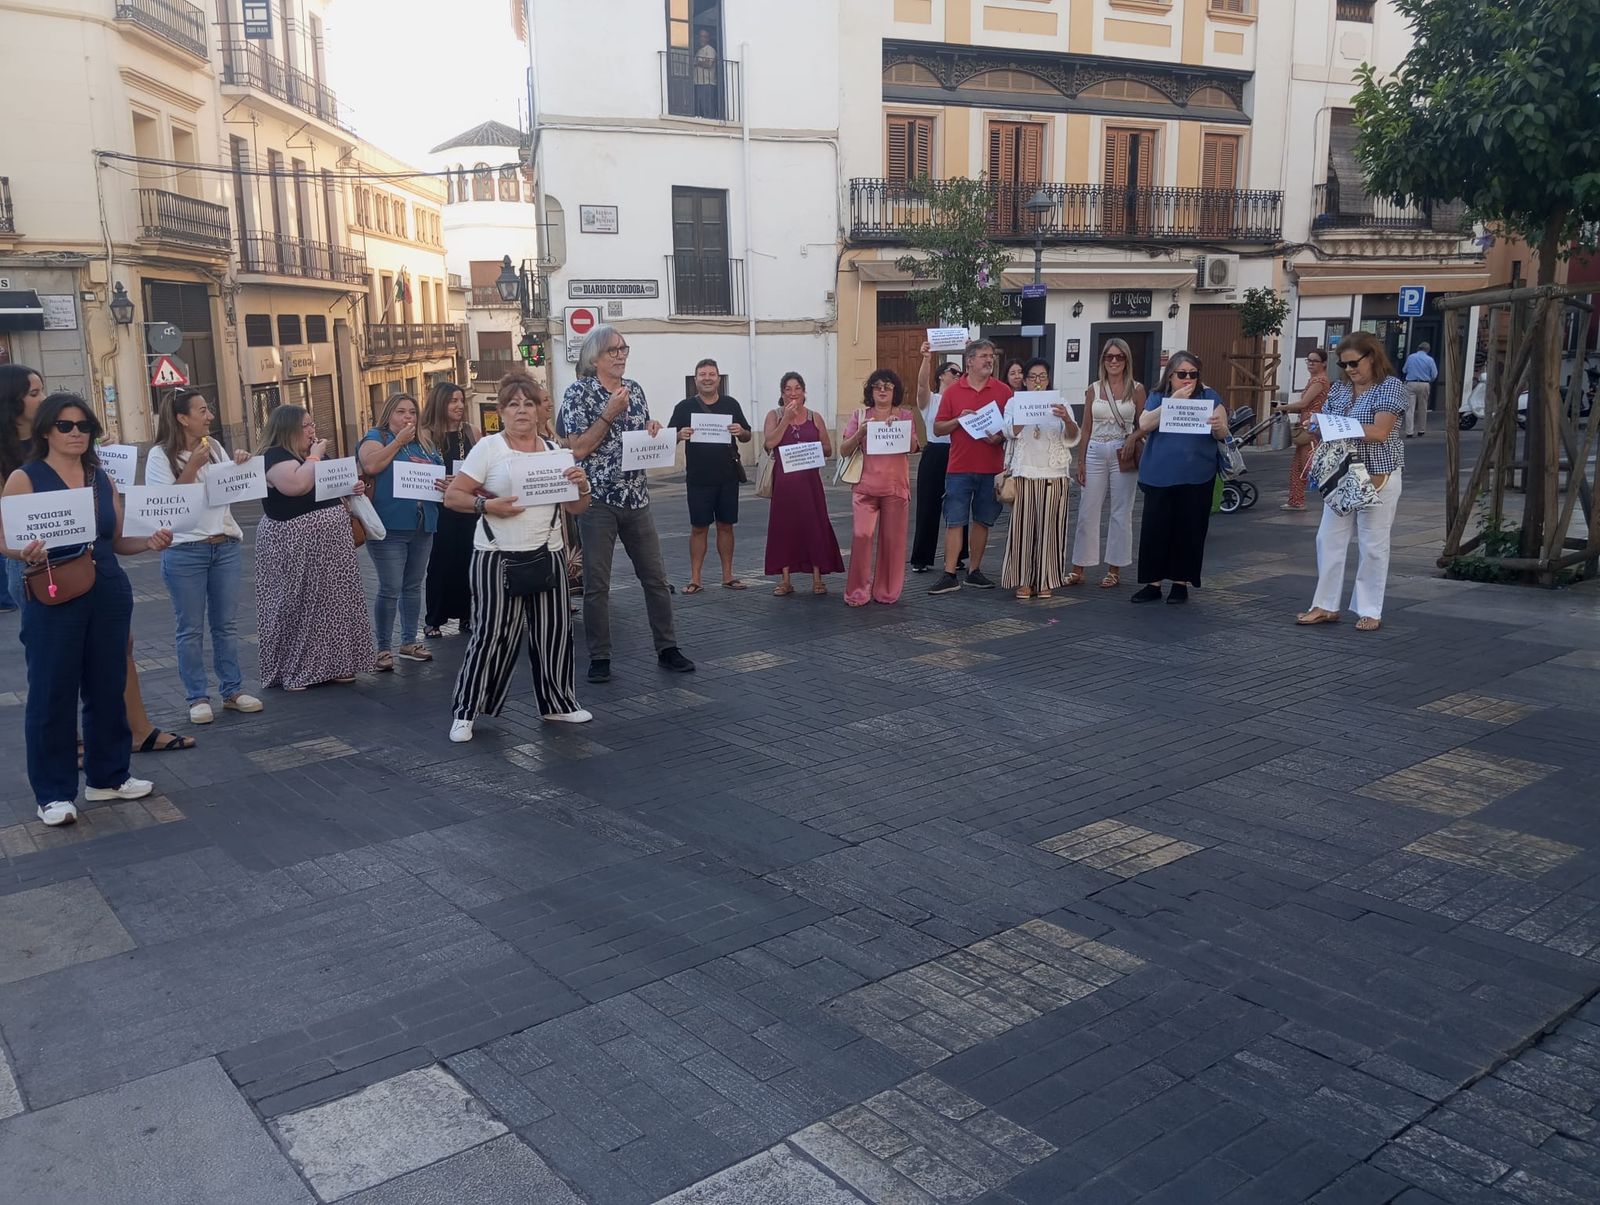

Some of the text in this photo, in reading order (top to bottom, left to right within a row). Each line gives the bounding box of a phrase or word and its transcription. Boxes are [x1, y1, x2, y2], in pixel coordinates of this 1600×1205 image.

[583, 285, 606, 294] DIARIO
[608, 285, 616, 294] DE
[1125, 292, 1150, 309] Relevo
[639, 444, 669, 452] JUDERÍA
[97, 450, 128, 460] URIDAD
[637, 453, 660, 461] EXISTE
[217, 472, 257, 486] LA JUDERÍA
[318, 473, 356, 483] COMPETENCIA
[400, 476, 430, 484] HACEMOS
[225, 484, 250, 493] EXISTE
[402, 483, 434, 491] DIFERENCI
[146, 496, 186, 506] POLICÍA
[28, 510, 72, 520] MEDIDAS
[140, 507, 190, 517] TURÍSTICA
[26, 520, 61, 531] TOMEN
[16, 526, 86, 541] EXIGIMOS QUE
